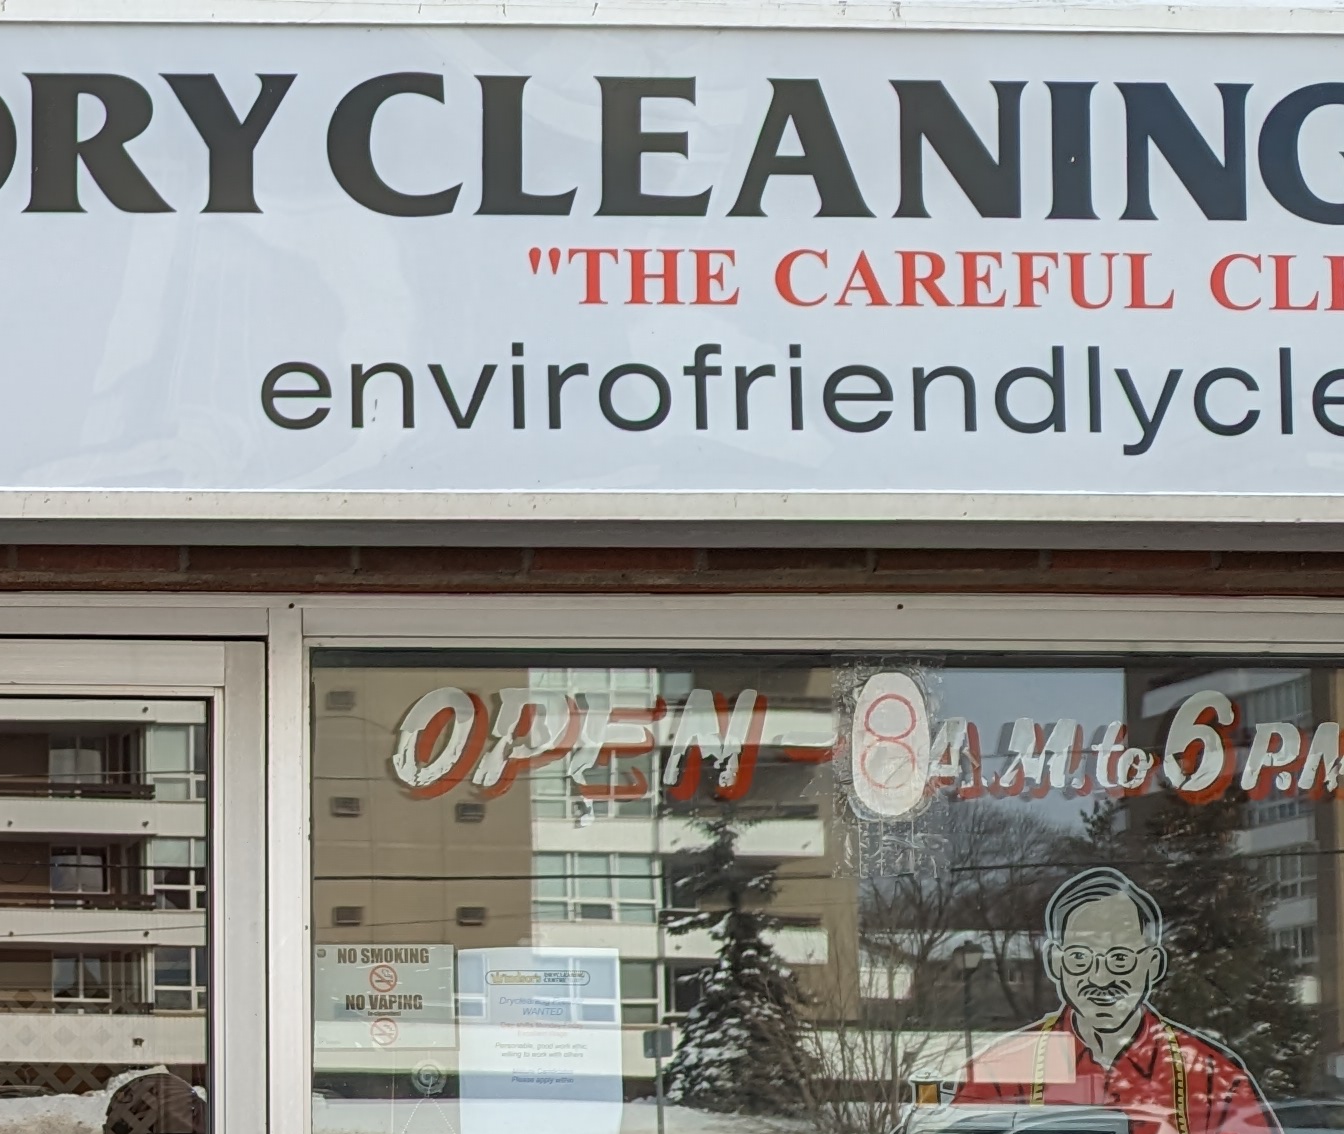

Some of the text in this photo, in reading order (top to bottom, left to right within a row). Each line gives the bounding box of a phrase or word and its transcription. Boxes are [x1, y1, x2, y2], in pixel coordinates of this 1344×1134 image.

[775, 248, 1174, 311] CAREFUL
[391, 686, 767, 799] OPEN
[1091, 720, 1158, 794] to
[1164, 690, 1239, 802] 6
[338, 948, 429, 964] NO SMOKING
[345, 994, 422, 1010] NO VAPING
[522, 1008, 563, 1016] WANTED
